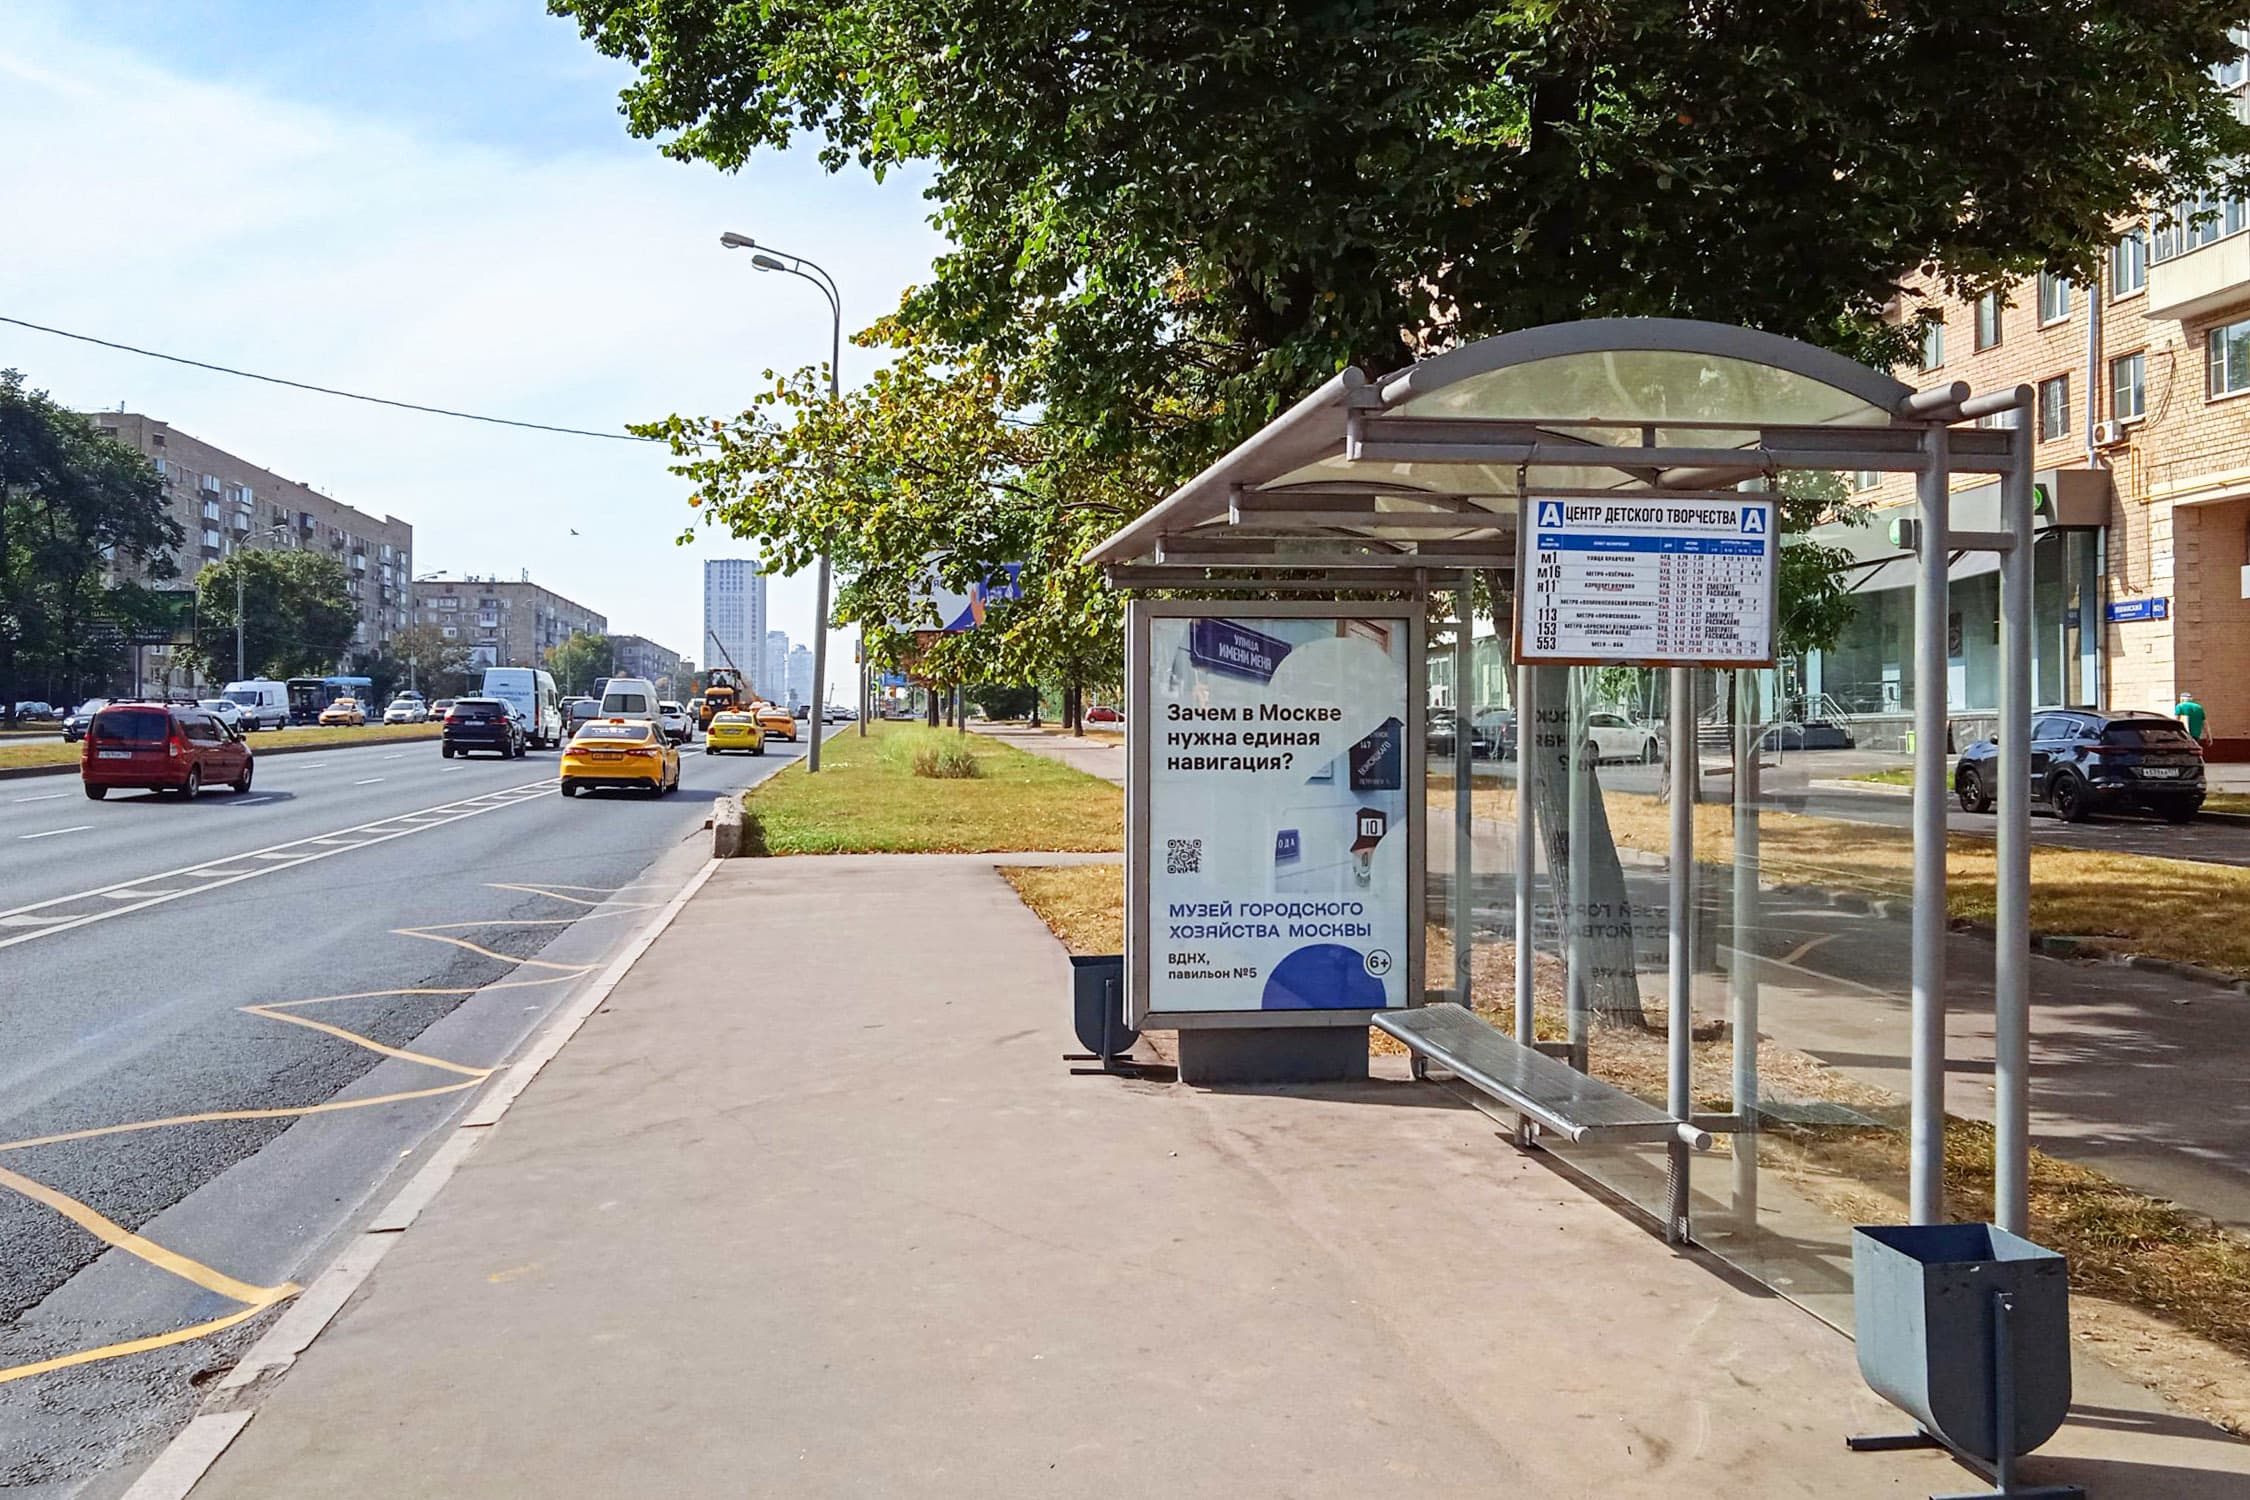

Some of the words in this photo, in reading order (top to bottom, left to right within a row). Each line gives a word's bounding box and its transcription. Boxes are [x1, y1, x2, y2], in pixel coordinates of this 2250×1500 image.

[1540, 503, 1561, 526] А
[1566, 506, 1602, 522] ЦЕНТР
[1605, 507, 1663, 524] ДЕТСКОГО
[1667, 509, 1737, 525] ТВОРЧЕСТВА
[1743, 509, 1764, 532] А
[1546, 594, 1550, 607] 1
[1538, 608, 1557, 621] 113
[1538, 622, 1557, 635] 153
[1234, 634, 1259, 652] УЛИЦА
[1537, 637, 1557, 650] 553
[1219, 642, 1249, 665] ИМЕНИ
[1250, 653, 1272, 671] МЕНЯ
[1168, 704, 1236, 721] Зачем
[1243, 707, 1254, 721] в
[1260, 704, 1342, 721] Москве
[1168, 732, 1237, 750] нужна
[1243, 732, 1320, 748] единая
[1168, 753, 1294, 772] навигация?
[1169, 901, 1232, 917] МУЗЕЙ
[1240, 902, 1363, 919] ГОРОДСКОГО
[1169, 922, 1280, 939] ХОЗЯЙСТВА
[1289, 923, 1371, 937] МОСКВЫ
[1168, 953, 1210, 965] ВДНХ,
[1369, 956, 1389, 968] 6+
[1168, 969, 1230, 979] павильон
[1233, 968, 1257, 979] №5
